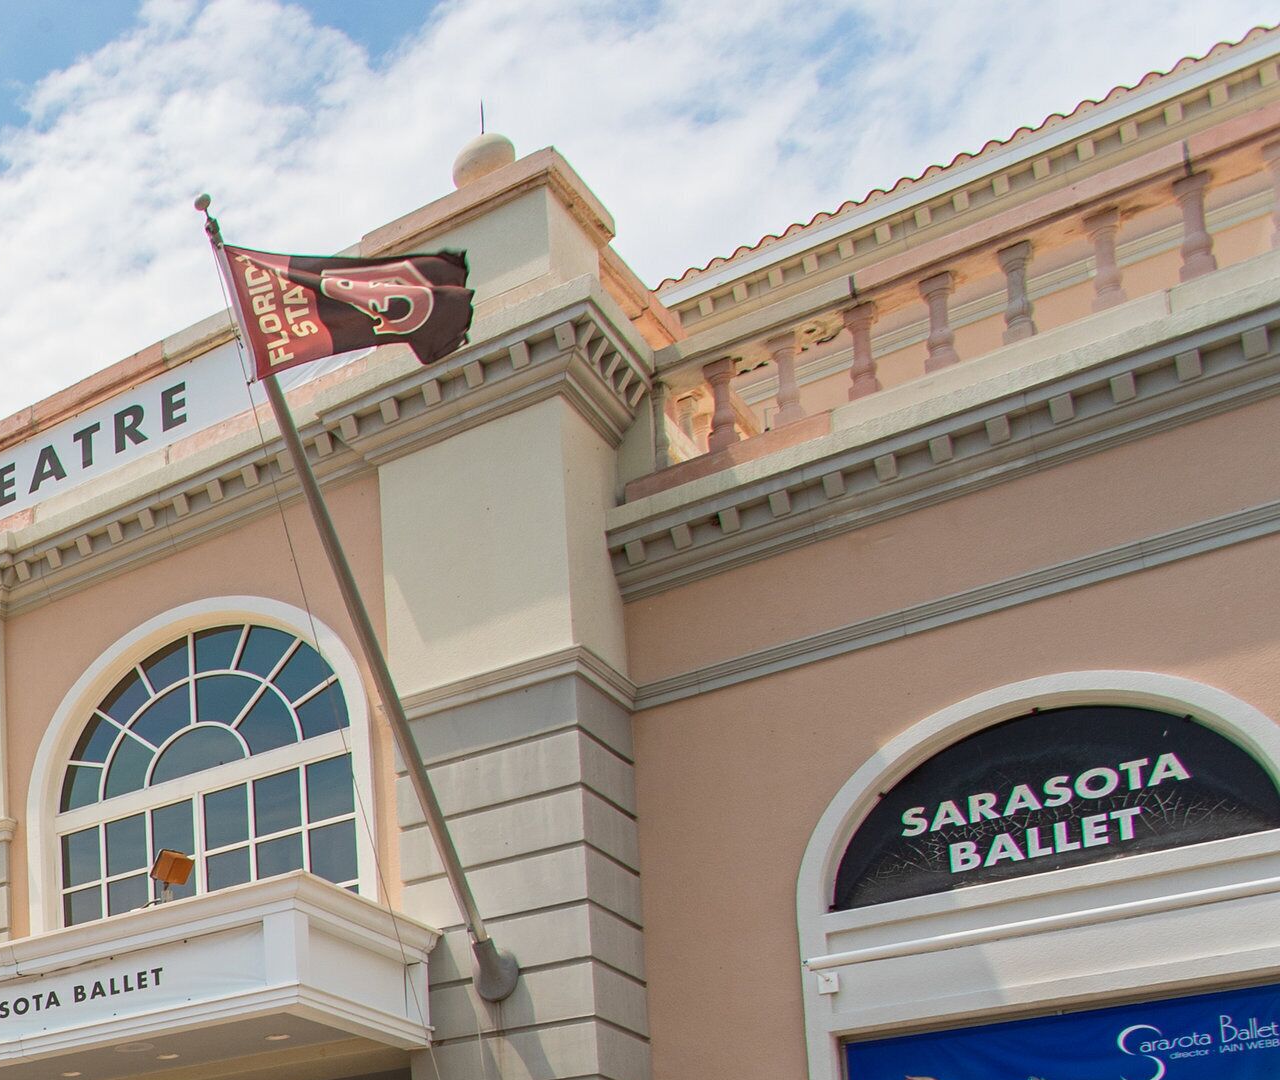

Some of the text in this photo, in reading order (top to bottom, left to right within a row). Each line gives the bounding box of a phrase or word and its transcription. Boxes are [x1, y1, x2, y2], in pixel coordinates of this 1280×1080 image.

[901, 752, 1192, 837] SARASOTA
[949, 806, 1144, 874] BALLET
[73, 967, 164, 1003] BALLET
[1219, 1015, 1279, 1043] Ballet
[1169, 1049, 1209, 1060] director
[1246, 1038, 1280, 1050] WEBB
